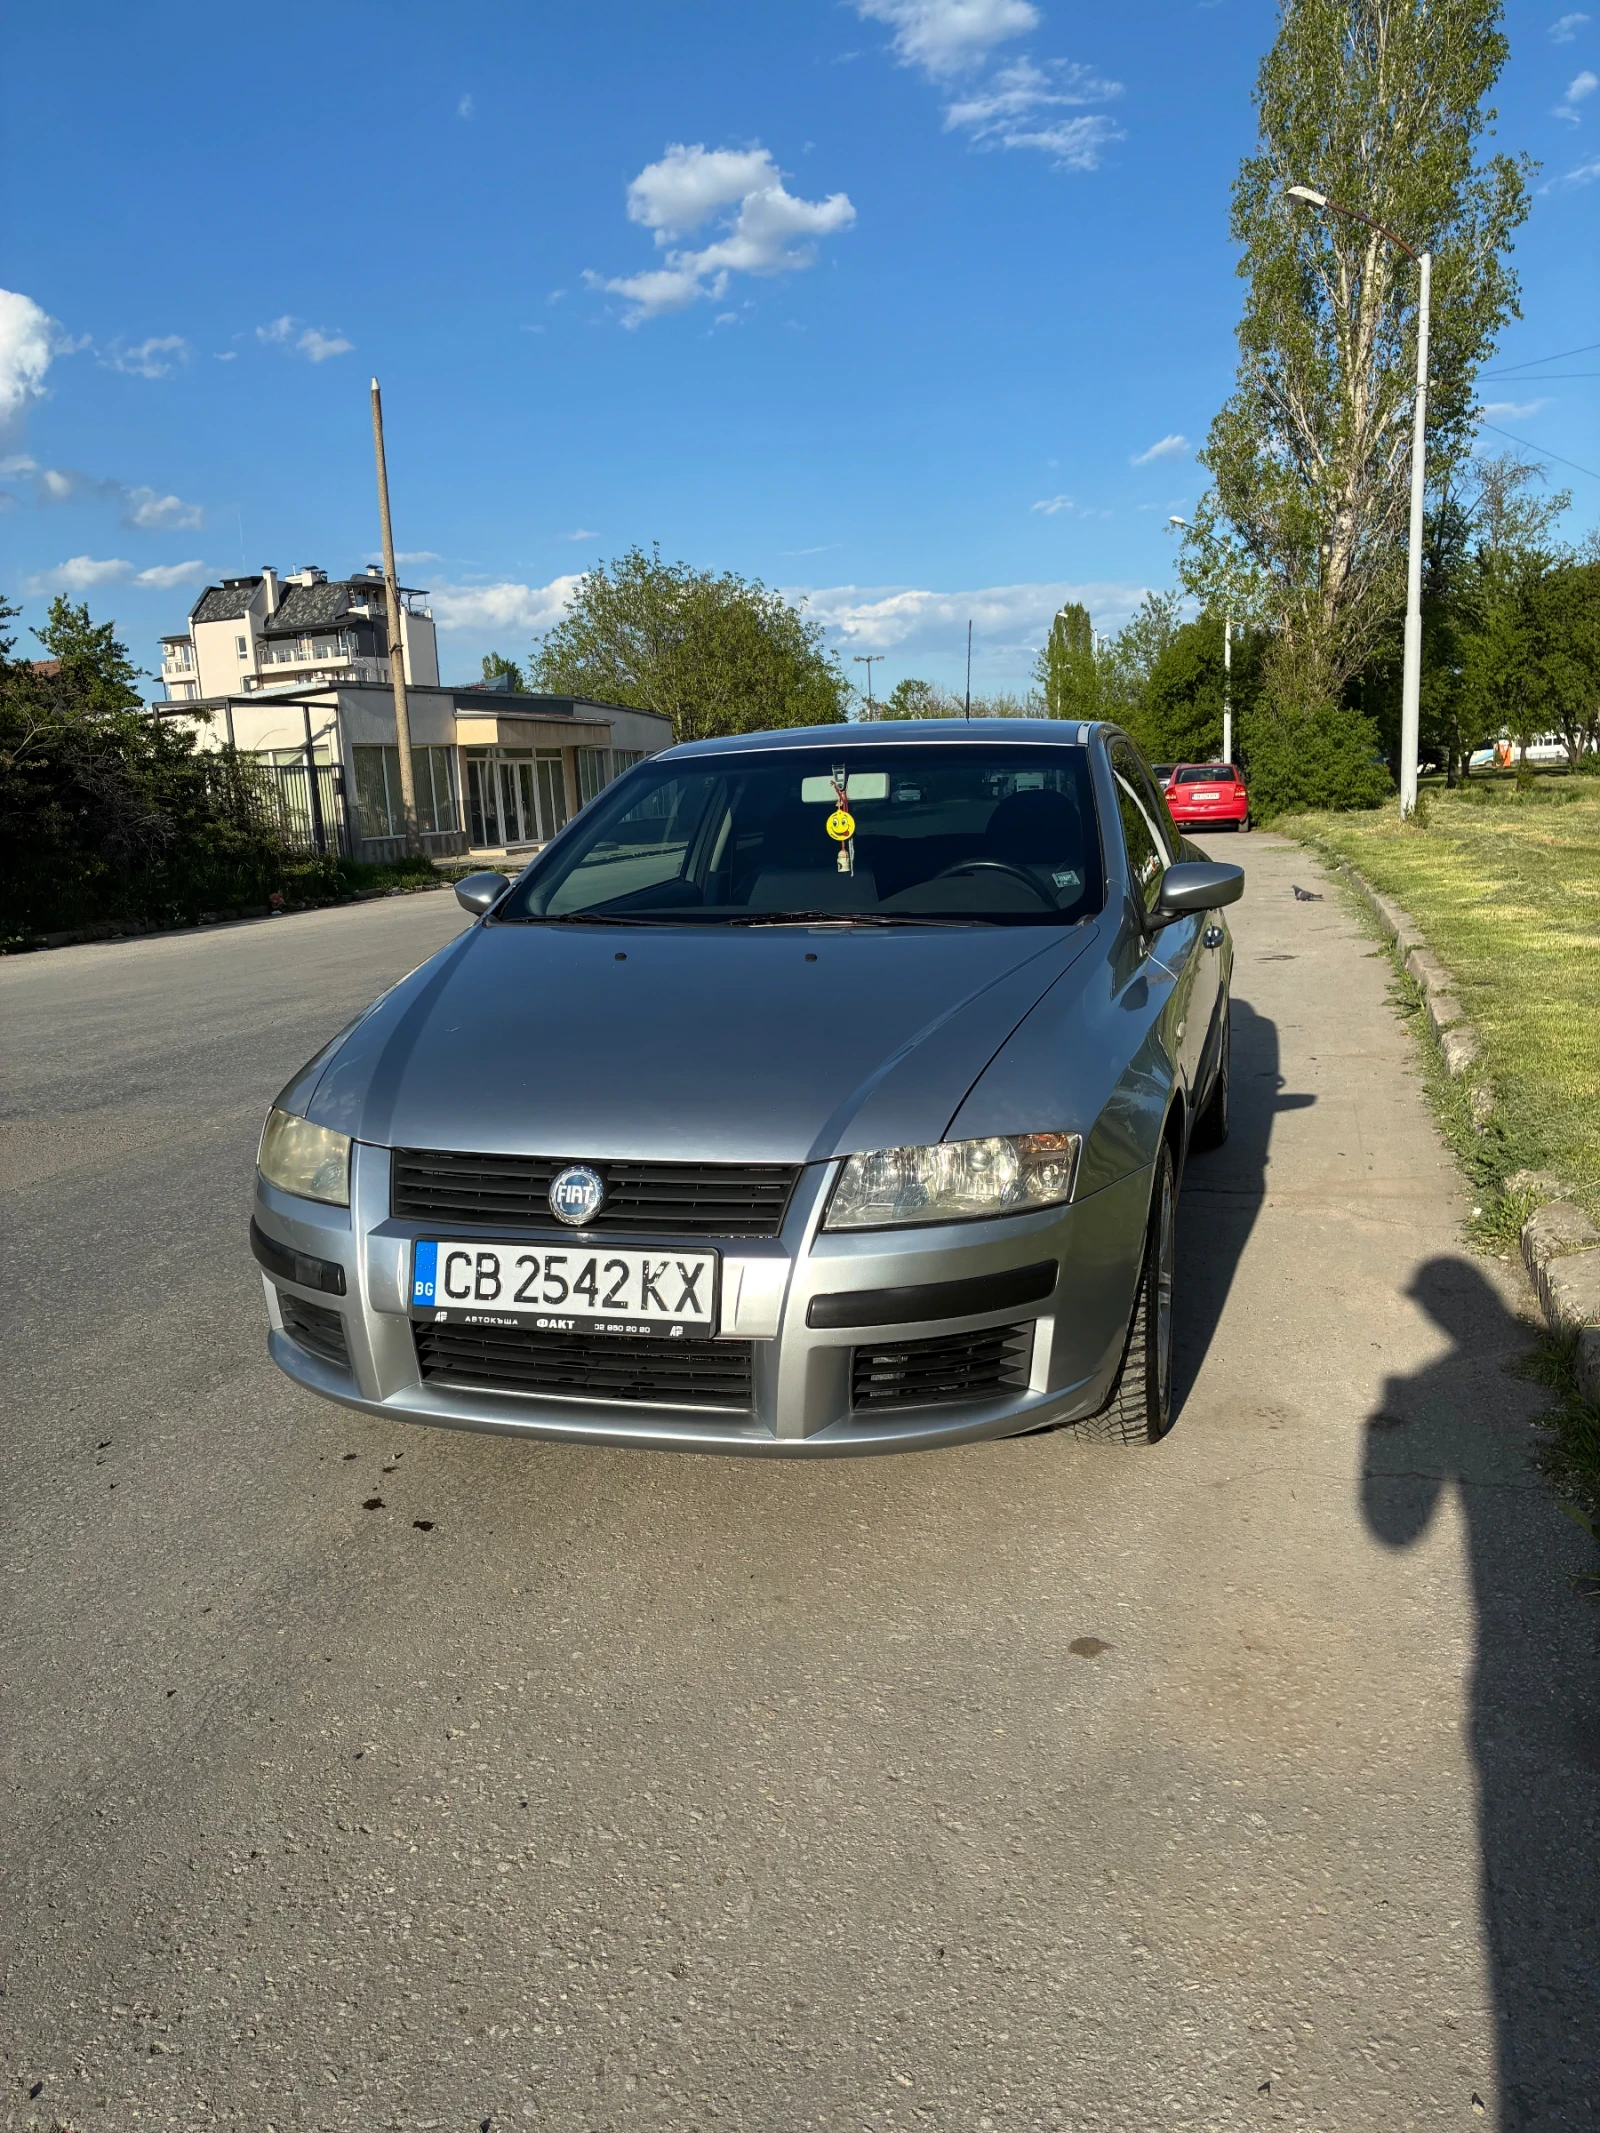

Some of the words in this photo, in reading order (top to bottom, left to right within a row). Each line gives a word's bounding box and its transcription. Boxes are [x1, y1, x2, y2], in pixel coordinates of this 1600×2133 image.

[557, 1185, 593, 1204] FIAT
[415, 1281, 434, 1296] BG
[444, 1251, 502, 1300] CB
[513, 1254, 630, 1309] 2542
[640, 1260, 705, 1314] KX
[464, 1315, 519, 1325] АВТОКЪША
[536, 1318, 575, 1329] ФАКТ
